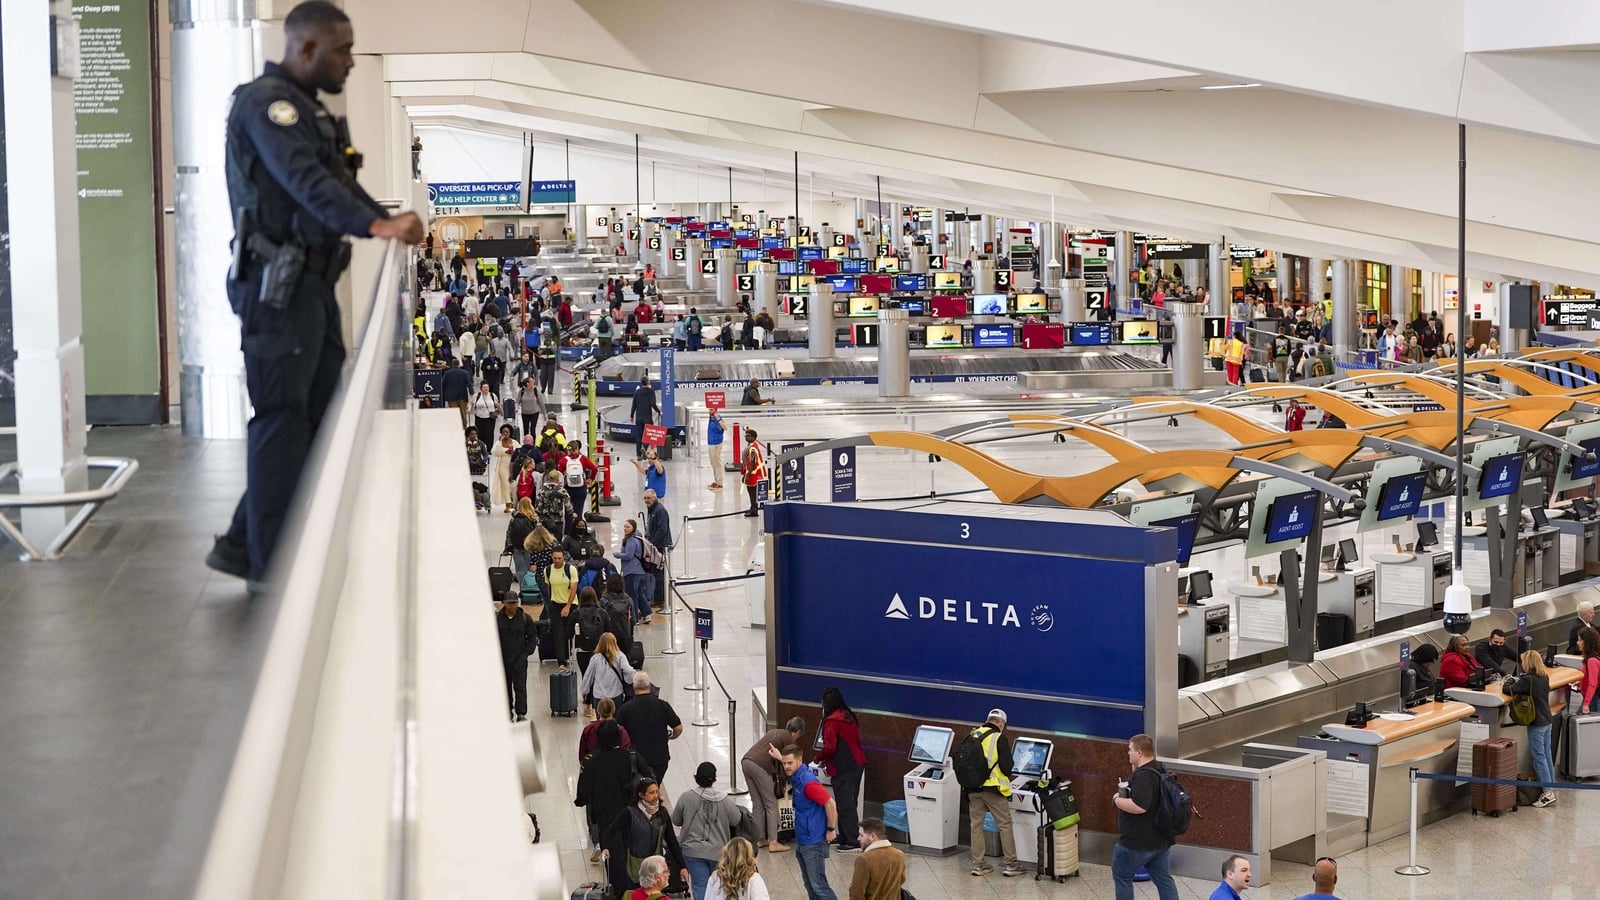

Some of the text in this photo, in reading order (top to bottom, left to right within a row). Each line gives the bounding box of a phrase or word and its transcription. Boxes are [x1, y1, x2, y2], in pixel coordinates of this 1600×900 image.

[85, 5, 101, 13] Deep
[102, 5, 120, 13] (2019)
[439, 183, 513, 192] OVERSIZE BAG PICK-UP
[454, 195, 471, 203] HELP
[471, 194, 498, 203] CENTER
[435, 206, 460, 215] ELTA
[599, 218, 606, 226] 9
[770, 221, 777, 229] 8
[614, 224, 621, 232] 8
[801, 227, 808, 236] 7
[632, 231, 639, 240] 7
[836, 235, 844, 245] 6
[650, 240, 659, 249] 6
[675, 249, 684, 259] 5
[704, 260, 714, 272] 4
[931, 256, 941, 268] 4
[998, 271, 1008, 284] 3
[741, 276, 752, 290] 3
[861, 284, 867, 293] 3
[1089, 293, 1101, 308] 2
[792, 298, 804, 314] 2
[932, 307, 938, 317] 2
[1211, 319, 1218, 337] 1
[863, 326, 870, 344] 1
[1024, 337, 1030, 348] 1
[714, 381, 743, 389] CHECKED
[1501, 481, 1512, 489] ASSIST
[961, 523, 970, 539] 3
[1278, 522, 1304, 533] AGENT ASSIST
[918, 595, 1021, 628] DELTA
[1031, 604, 1049, 626] SKYTEAM
[697, 617, 711, 626] EXIT
